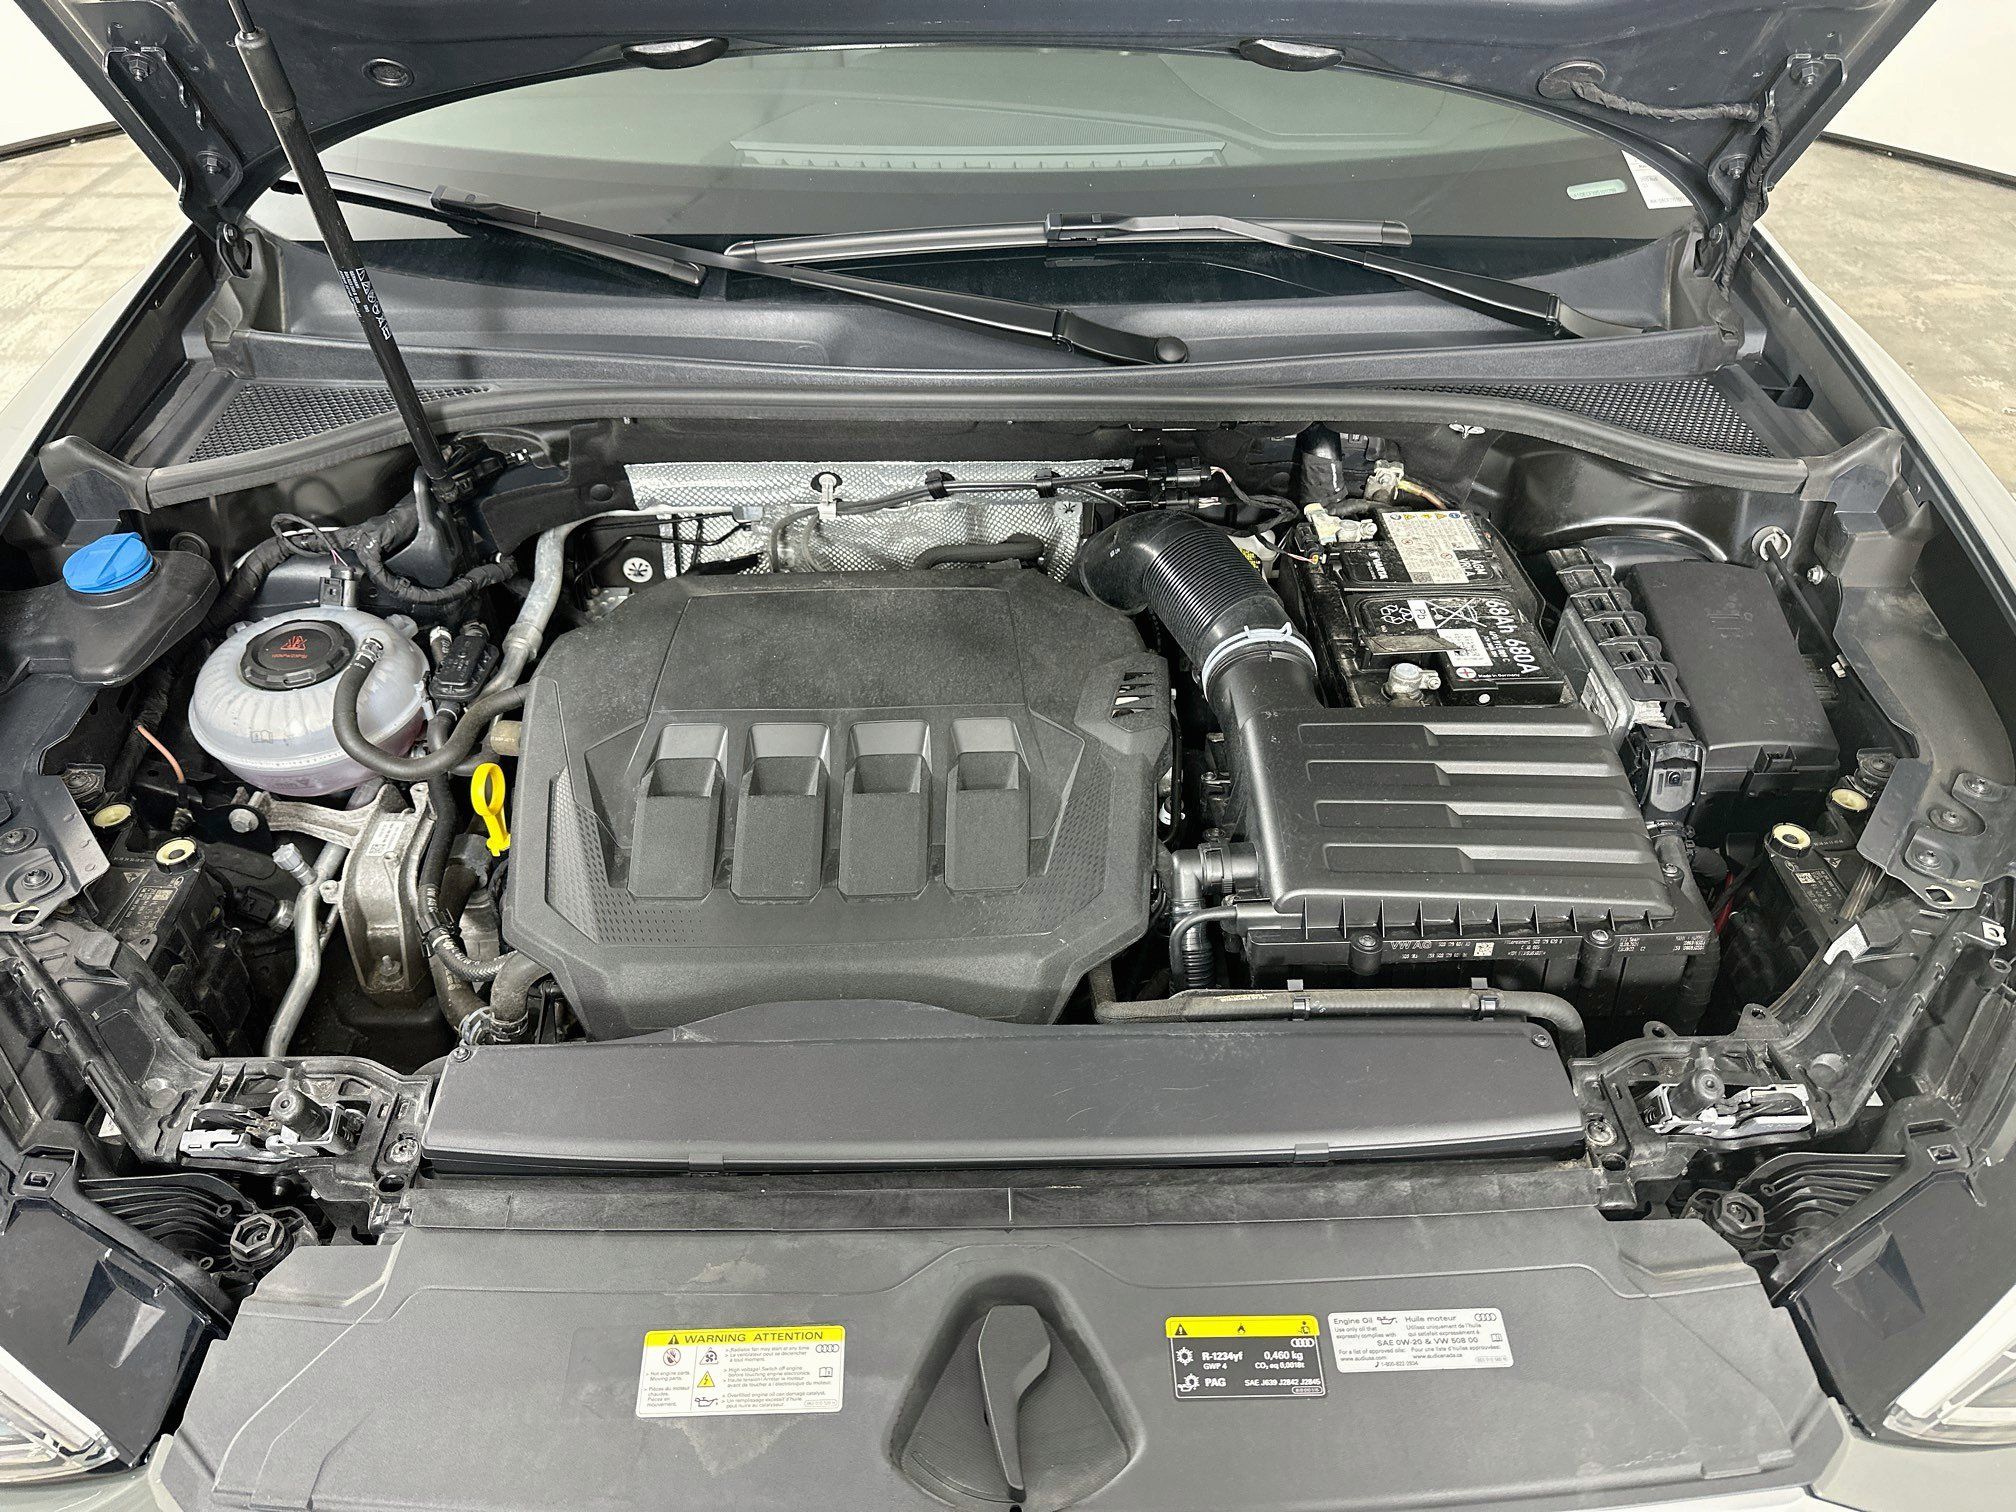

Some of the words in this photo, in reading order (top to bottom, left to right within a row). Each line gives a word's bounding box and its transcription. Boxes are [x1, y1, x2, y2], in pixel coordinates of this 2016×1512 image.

[1469, 560, 1488, 575] AGM
[1413, 608, 1427, 620] Pb
[1485, 600, 1518, 633] 68Ah
[1504, 639, 1541, 674] 680A
[1391, 940, 1411, 950] VW
[1413, 939, 1433, 949] AG
[1333, 1317, 1360, 1325] Engine
[684, 1333, 746, 1343] WARNING
[752, 1331, 823, 1341] ATTENTION
[1202, 1351, 1243, 1362] R-1234yf
[1264, 1351, 1290, 1361] 0,460
[1291, 1351, 1304, 1361] kg
[1205, 1378, 1226, 1387] PAG
